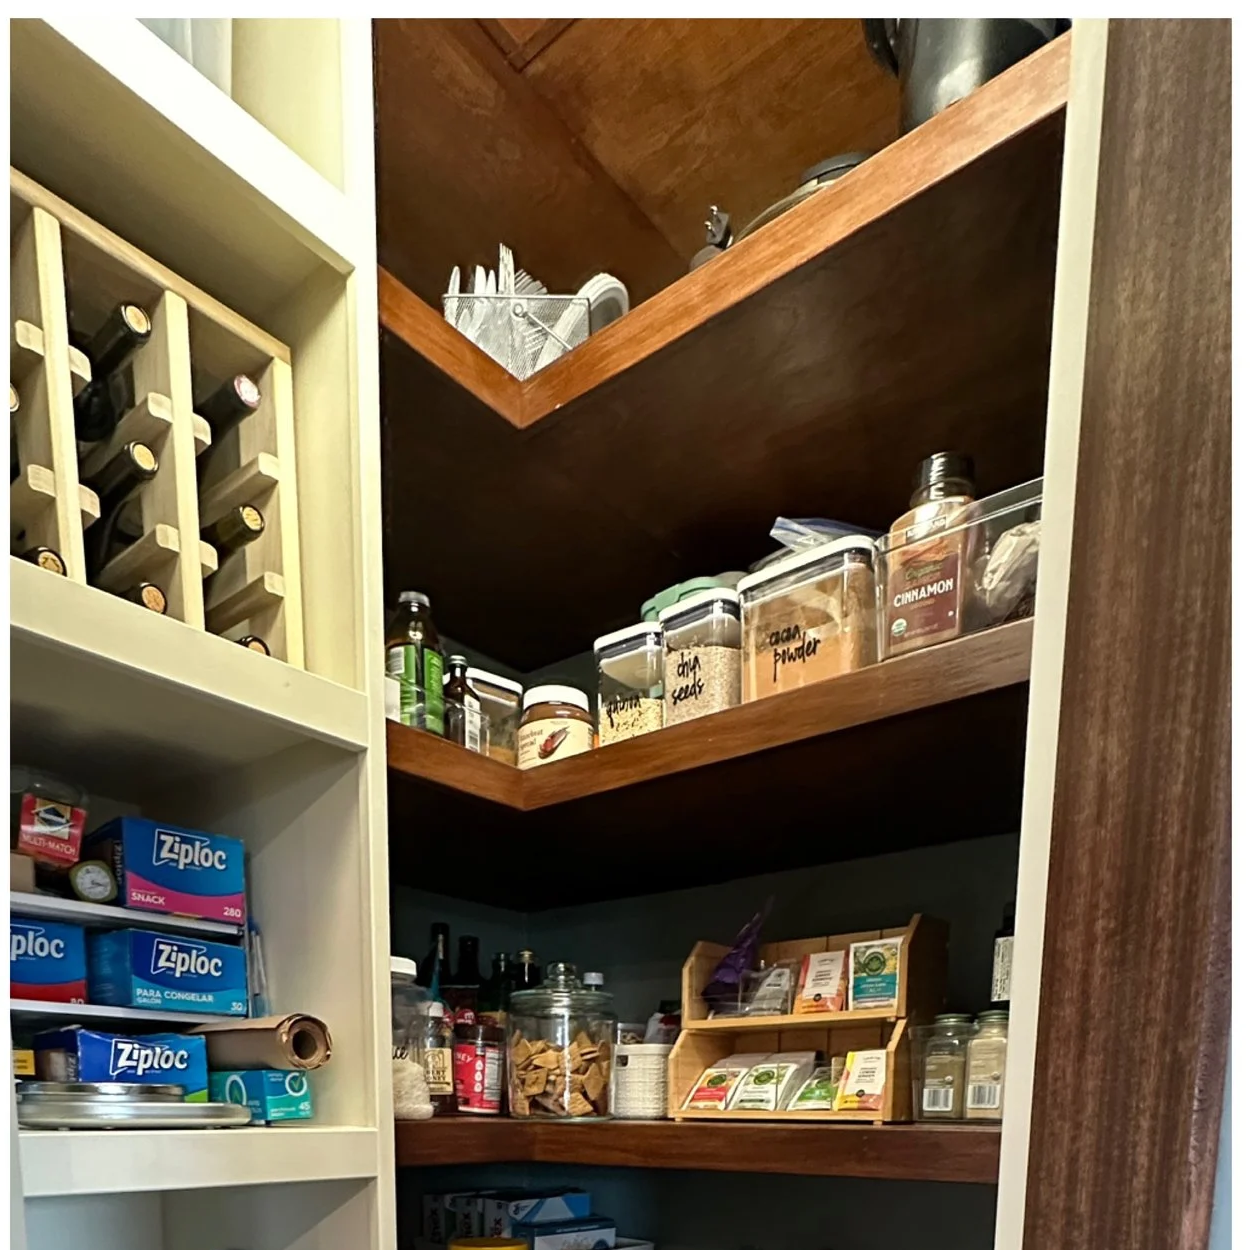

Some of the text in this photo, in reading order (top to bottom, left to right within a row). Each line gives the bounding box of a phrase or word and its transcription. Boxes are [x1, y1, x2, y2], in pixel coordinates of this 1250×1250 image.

[893, 578, 954, 608] CINNAMON
[676, 650, 701, 679] chia
[773, 632, 821, 683] powder
[671, 677, 705, 706] seeds
[21, 833, 76, 856] MULTI-MATCH
[158, 832, 227, 871] Ziploc
[130, 890, 242, 918] SNACK 280
[157, 942, 223, 978] Ziploc
[136, 988, 244, 1012] PARA CONGELAR 30
[116, 1043, 188, 1077] Ziploc
